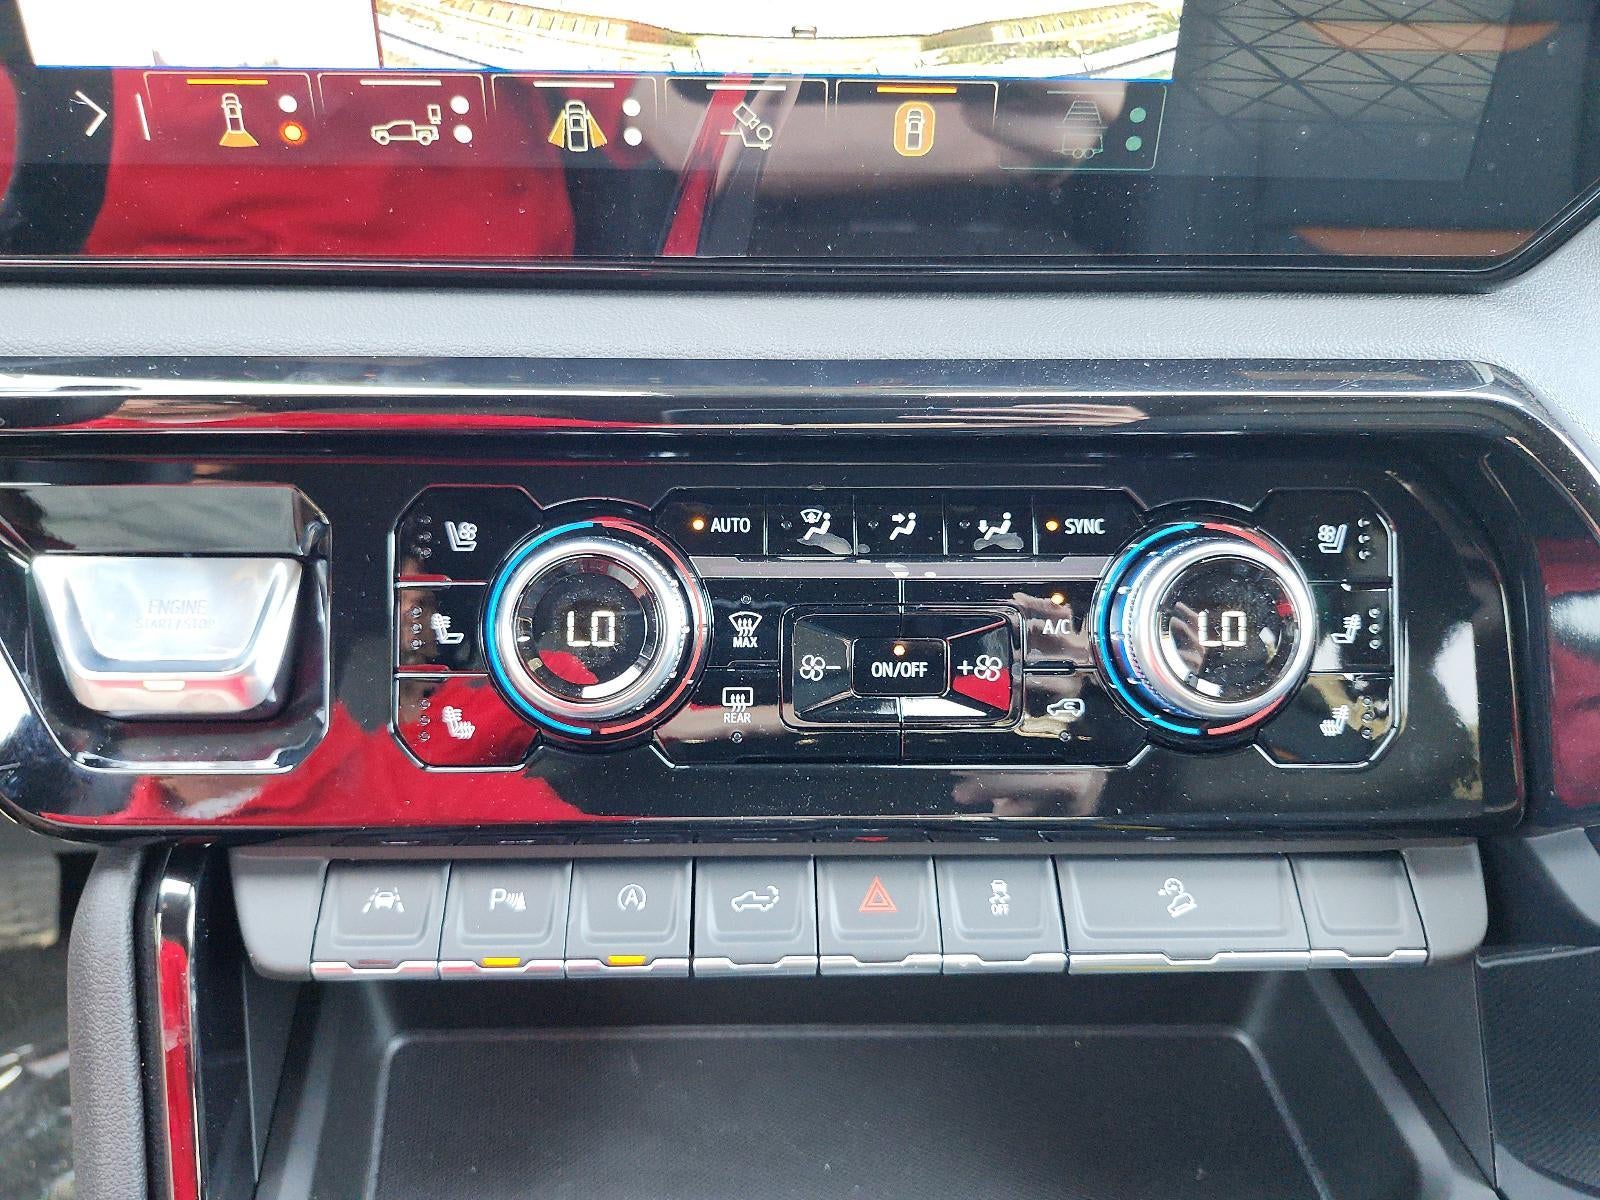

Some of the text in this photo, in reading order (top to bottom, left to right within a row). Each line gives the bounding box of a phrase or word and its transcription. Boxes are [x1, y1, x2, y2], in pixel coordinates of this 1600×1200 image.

[711, 517, 751, 533] AUTO
[1064, 518, 1106, 535] SYNC
[147, 599, 209, 615] ENGINE
[567, 611, 615, 647] LO
[1042, 618, 1072, 635] A/C
[1198, 610, 1247, 647] LO
[732, 636, 758, 648] MAX
[871, 661, 928, 679] ON/OFF
[723, 711, 752, 724] REAR
[490, 888, 507, 911] P
[990, 903, 1009, 917] OFF
